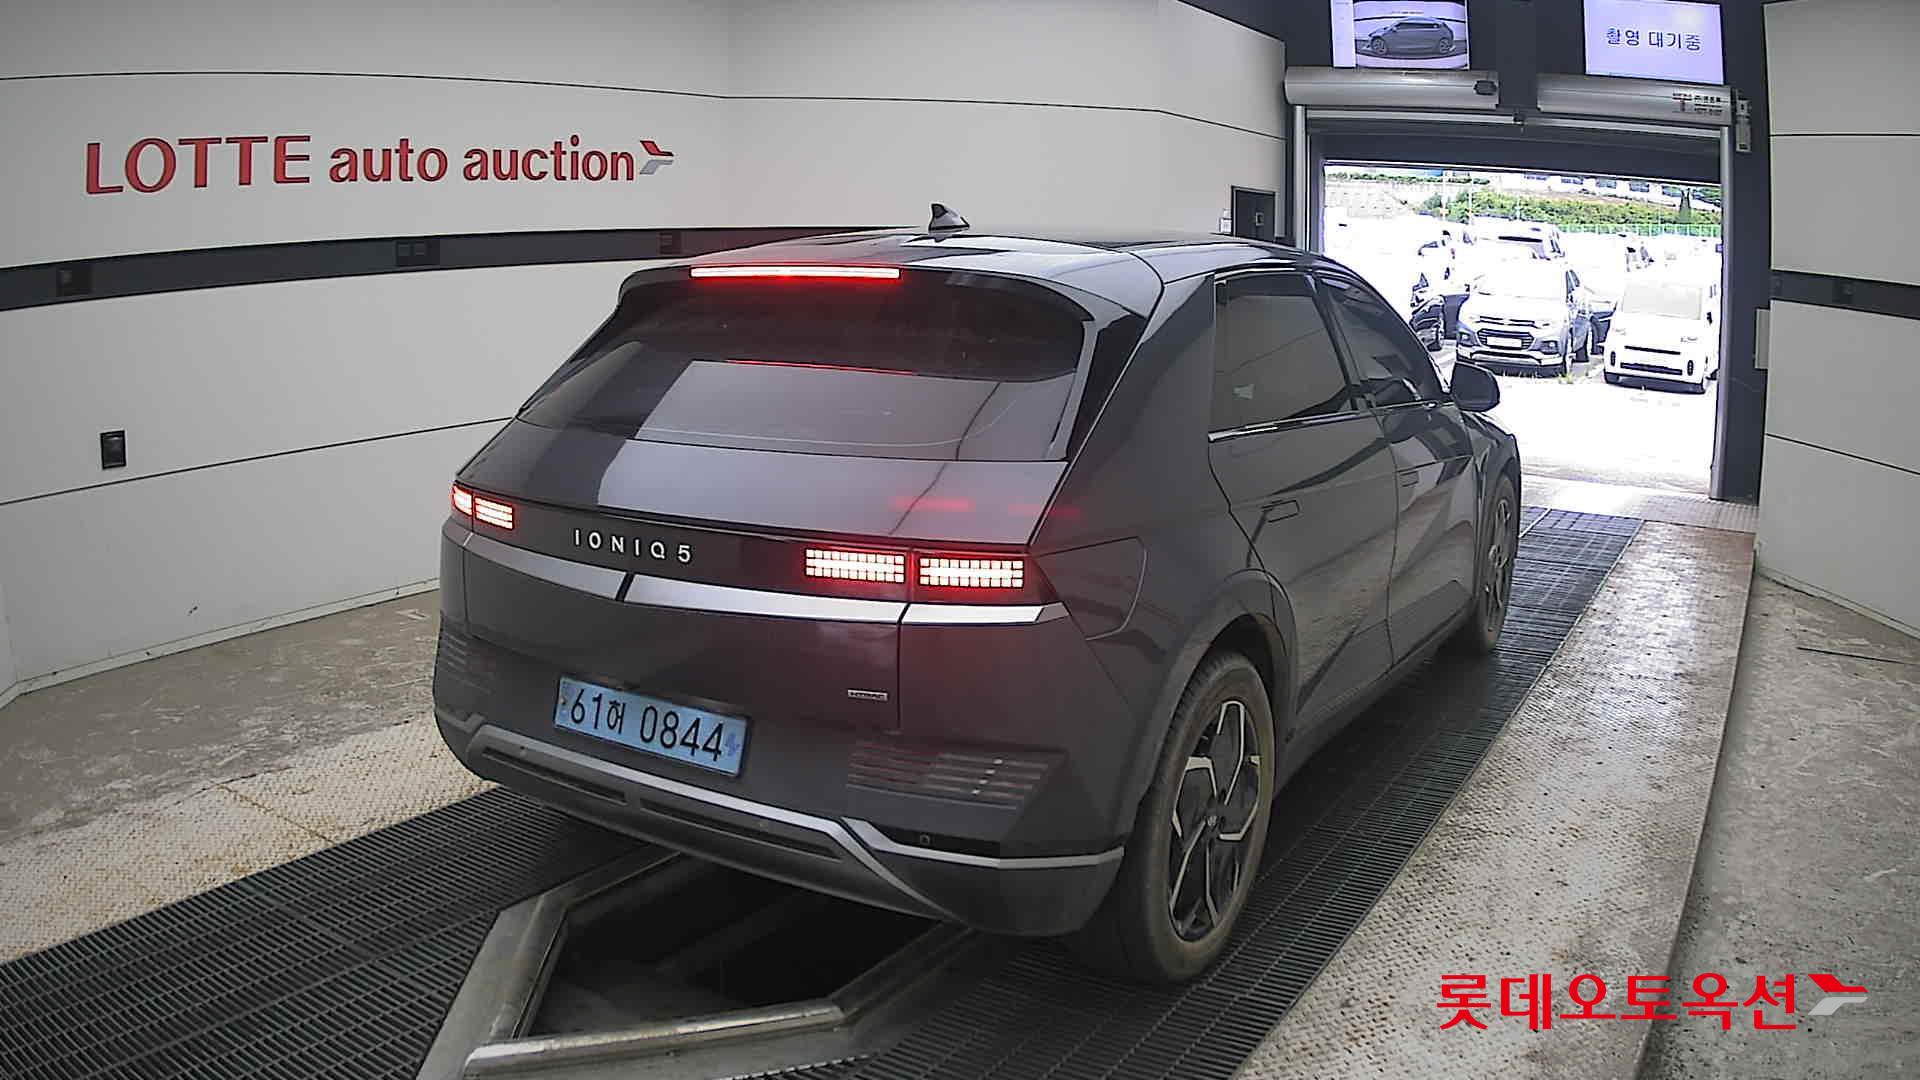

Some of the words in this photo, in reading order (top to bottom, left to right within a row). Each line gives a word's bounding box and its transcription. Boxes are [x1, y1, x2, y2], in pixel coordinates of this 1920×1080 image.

[1648, 31, 1701, 51] 대기중
[86, 135, 310, 194] LOTTE
[329, 140, 448, 182] auto
[463, 134, 634, 182] auction
[570, 688, 627, 735] 61허
[639, 705, 725, 762] 0844
